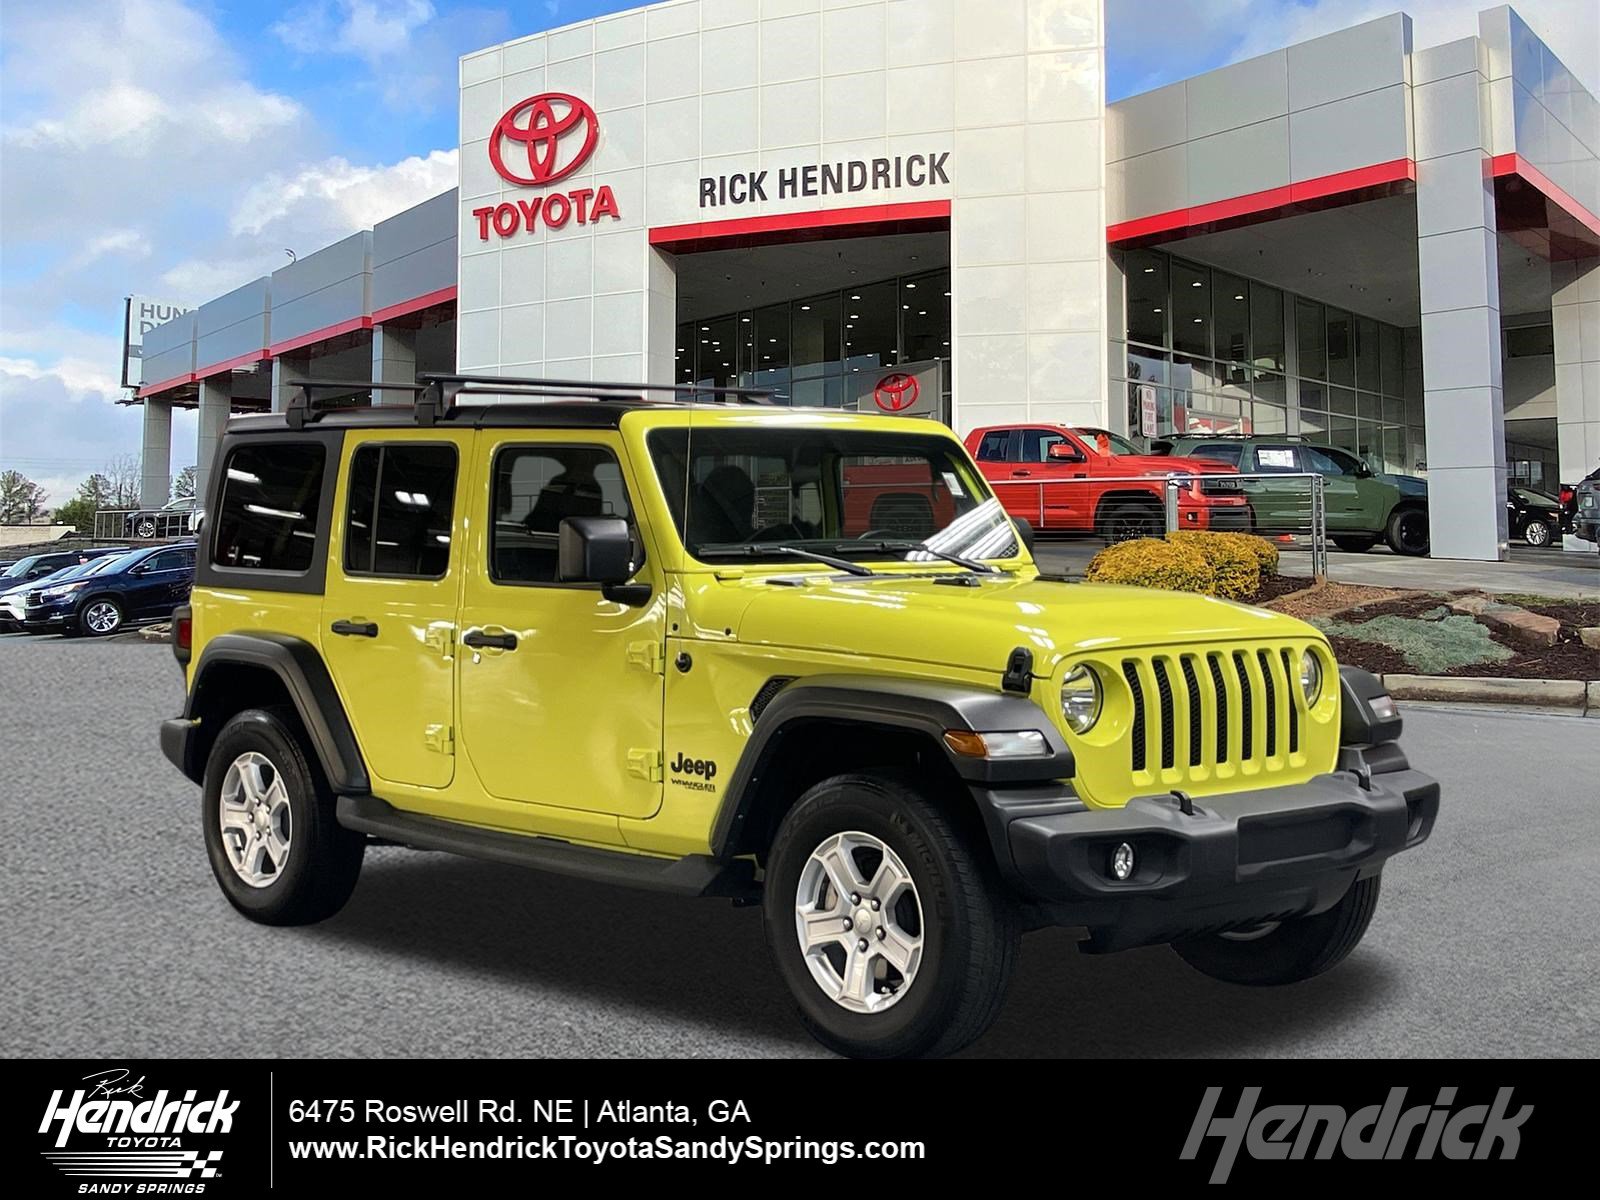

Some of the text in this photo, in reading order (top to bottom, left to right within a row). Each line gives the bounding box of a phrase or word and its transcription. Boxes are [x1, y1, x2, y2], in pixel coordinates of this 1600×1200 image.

[699, 152, 950, 208] RICK HENDRICK
[473, 185, 620, 241] TOYOTA
[670, 751, 717, 781] Jeep
